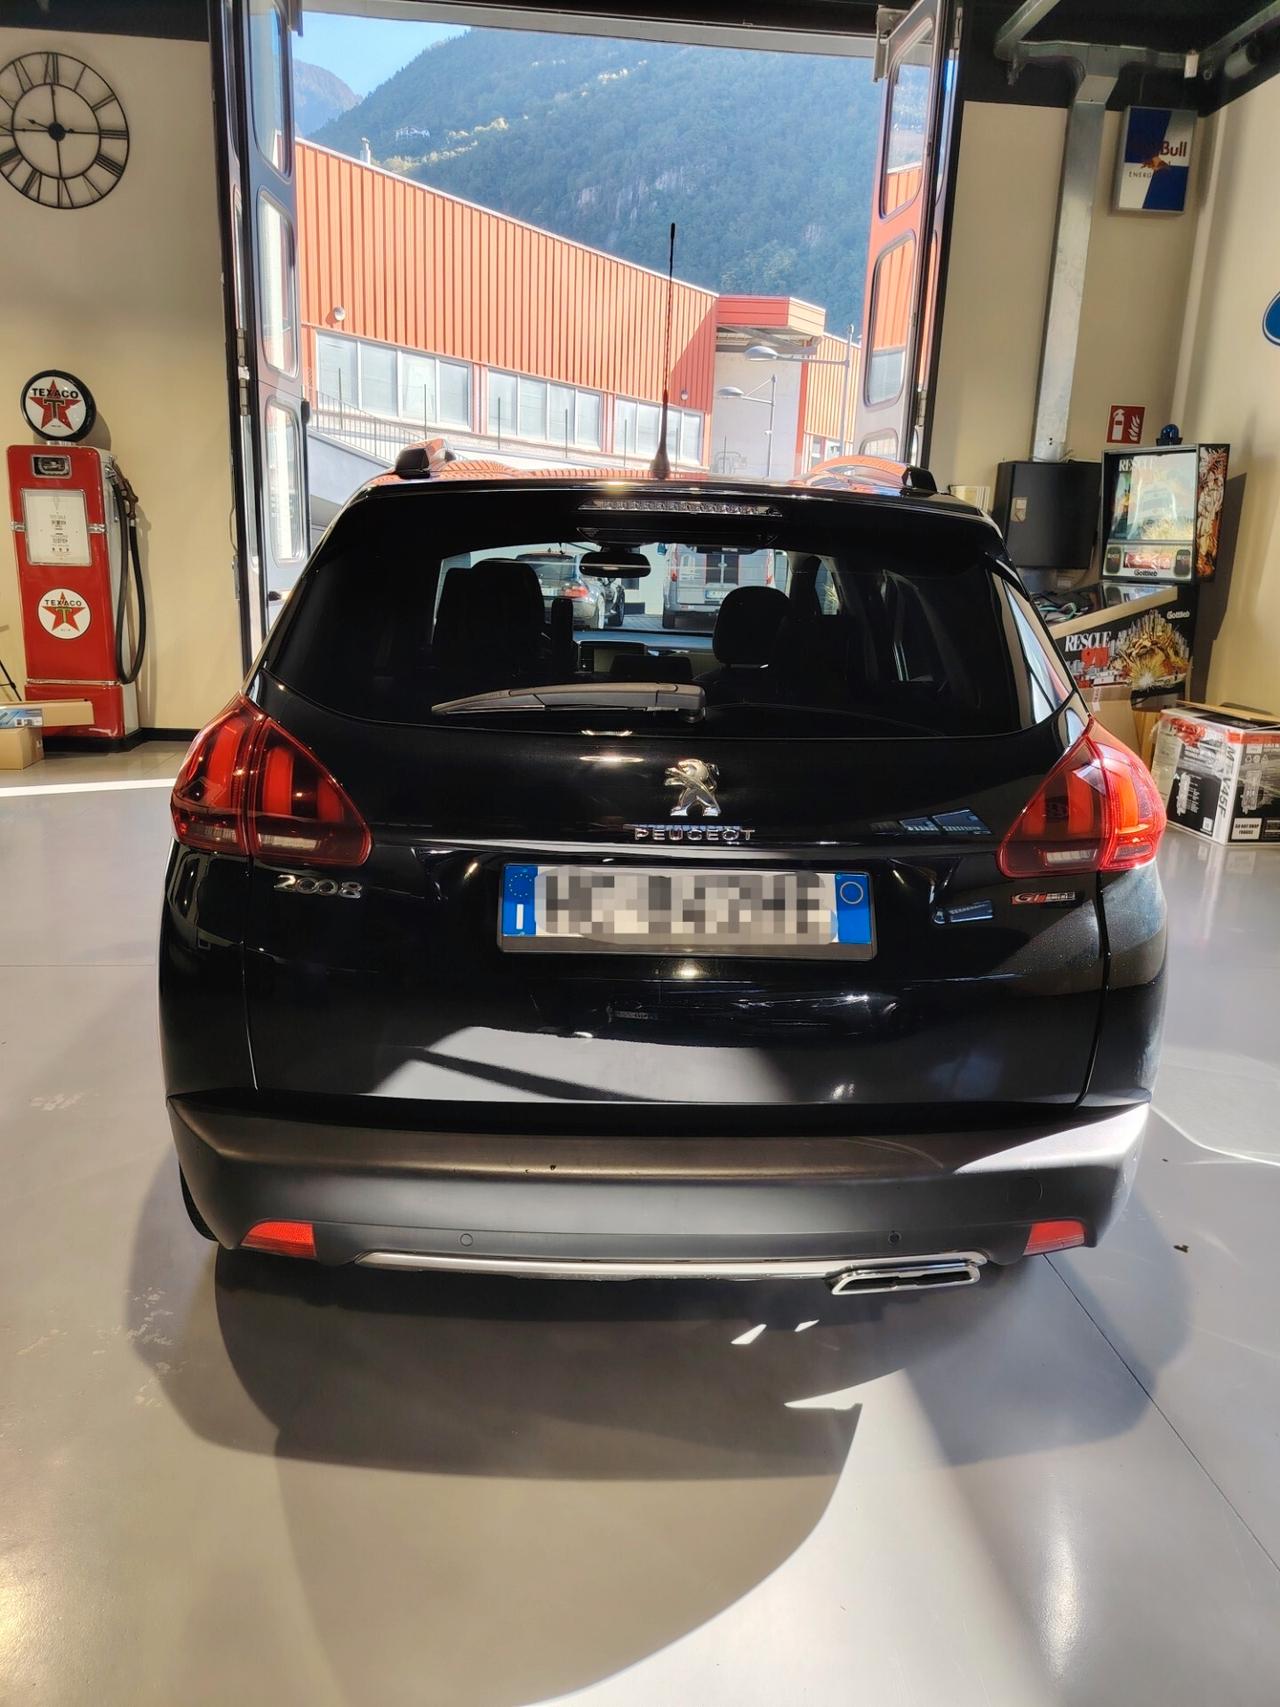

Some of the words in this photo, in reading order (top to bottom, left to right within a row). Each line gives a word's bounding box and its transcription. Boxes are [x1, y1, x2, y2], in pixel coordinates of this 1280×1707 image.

[1160, 140, 1188, 157] Bull
[31, 387, 79, 399] TEXACO
[45, 599, 82, 607] TEXACO
[633, 827, 756, 841] PEUGEOT
[273, 874, 363, 899] 2008
